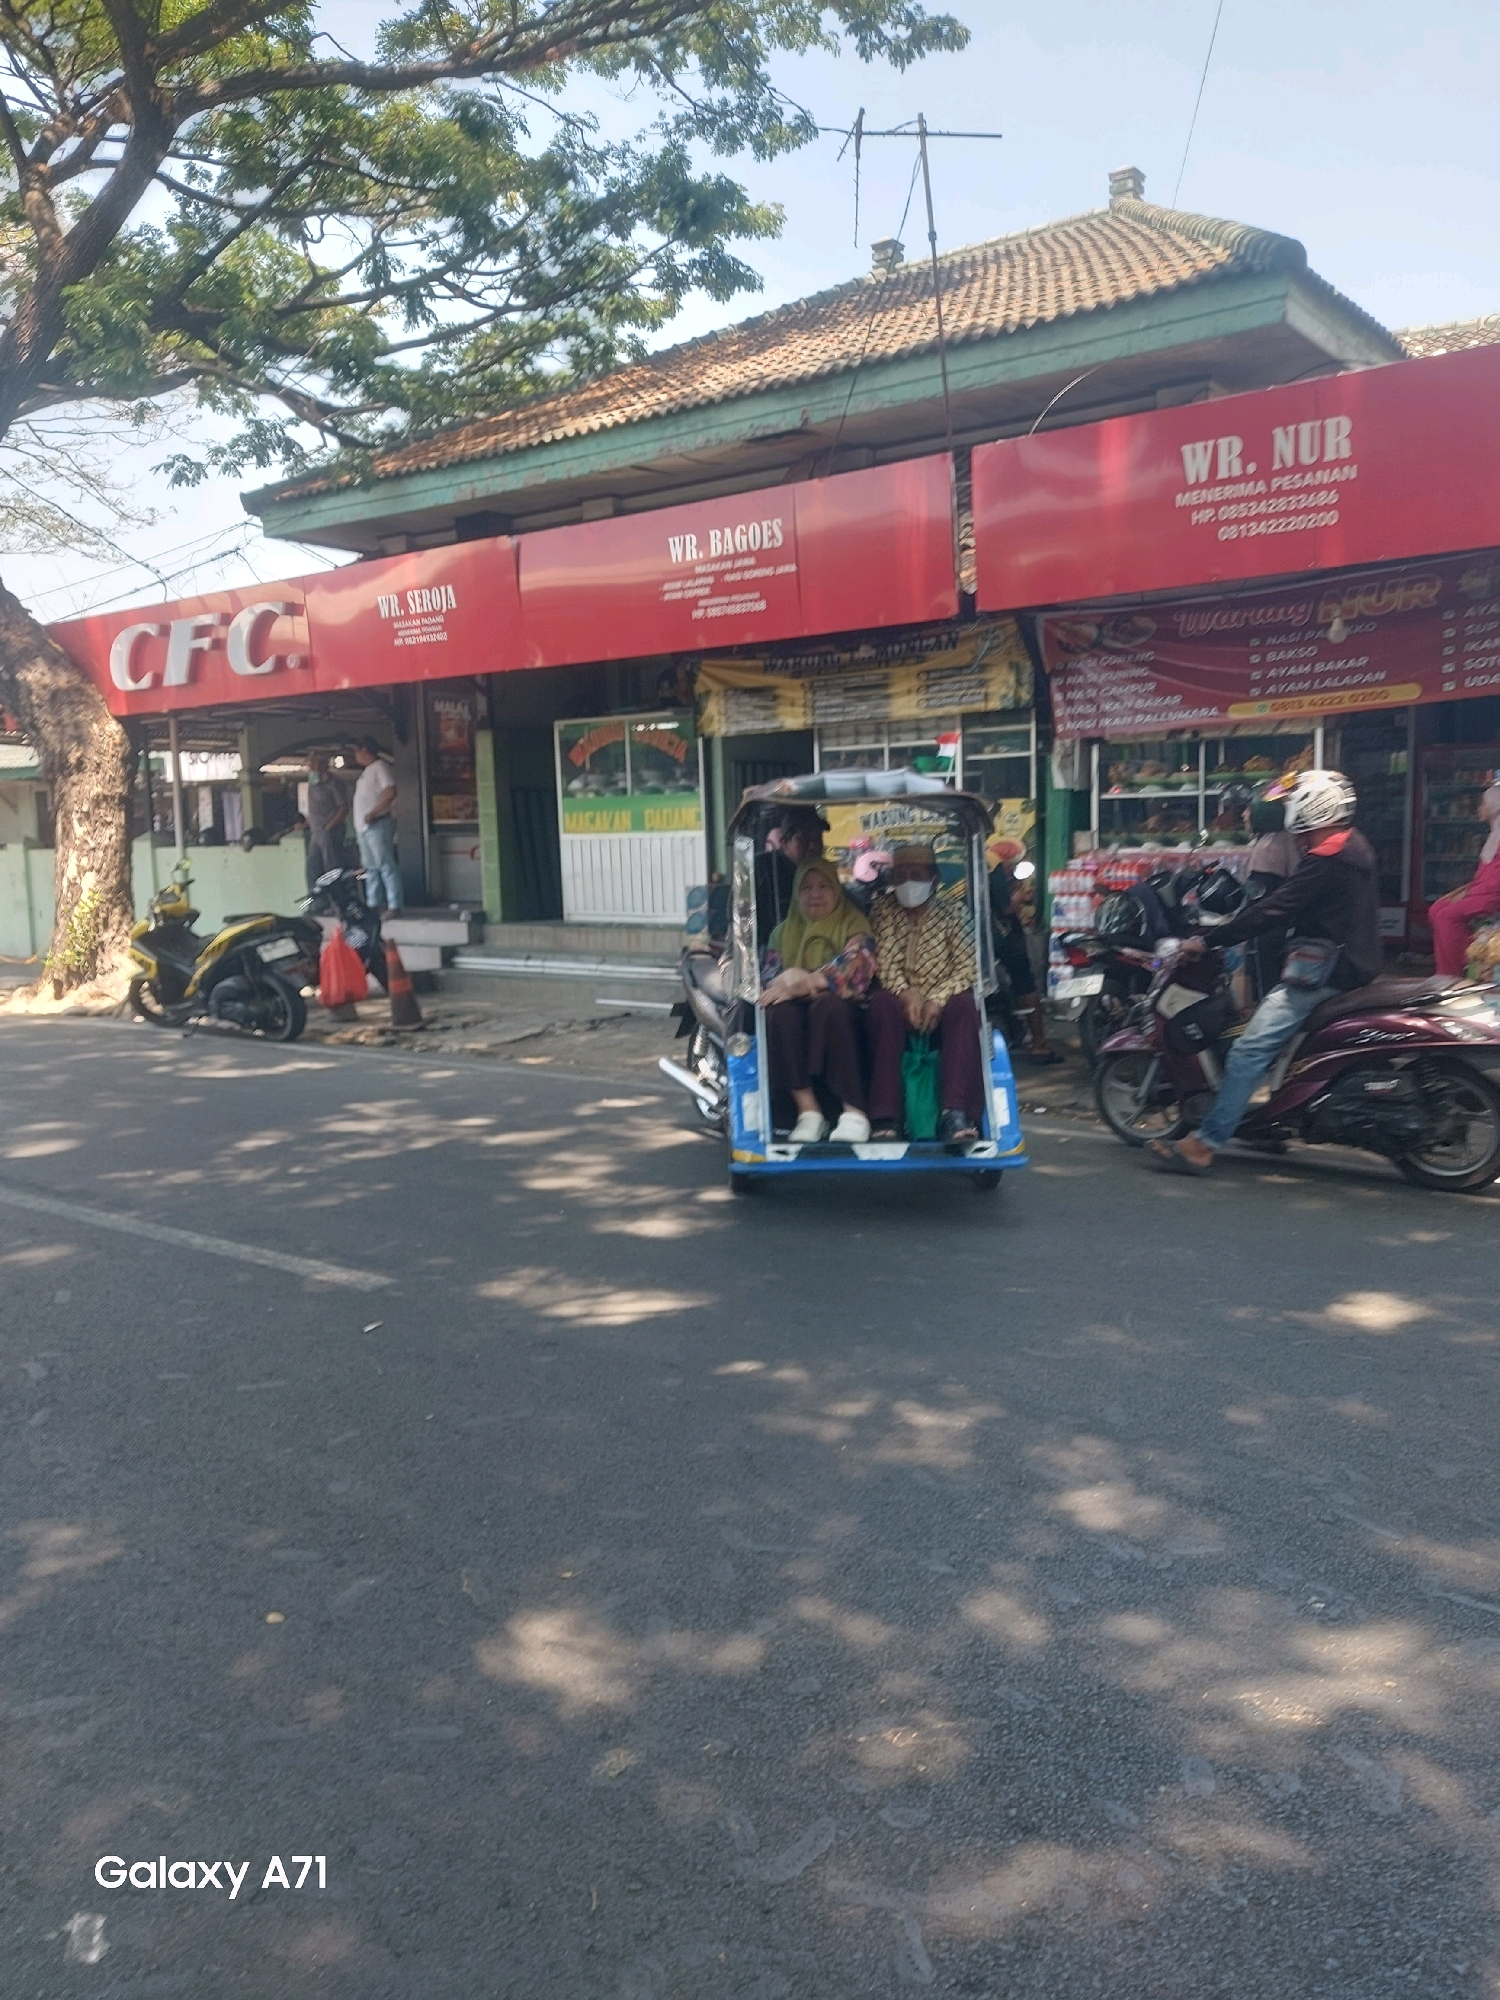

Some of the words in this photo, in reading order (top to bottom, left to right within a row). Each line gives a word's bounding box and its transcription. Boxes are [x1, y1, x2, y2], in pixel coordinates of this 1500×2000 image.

[1180, 435, 1257, 485] WR.
[1271, 415, 1353, 471] NUR
[1175, 480, 1268, 508] MENERIMA
[1271, 464, 1358, 493] PESANAN
[667, 534, 704, 564] WR.
[708, 518, 783, 558] BAGOES
[377, 593, 405, 619] WR.
[406, 584, 457, 614] SEROJA
[1316, 573, 1443, 624] NUR
[1265, 645, 1319, 663] BAKSO
[1312, 656, 1371, 674] BAKAR
